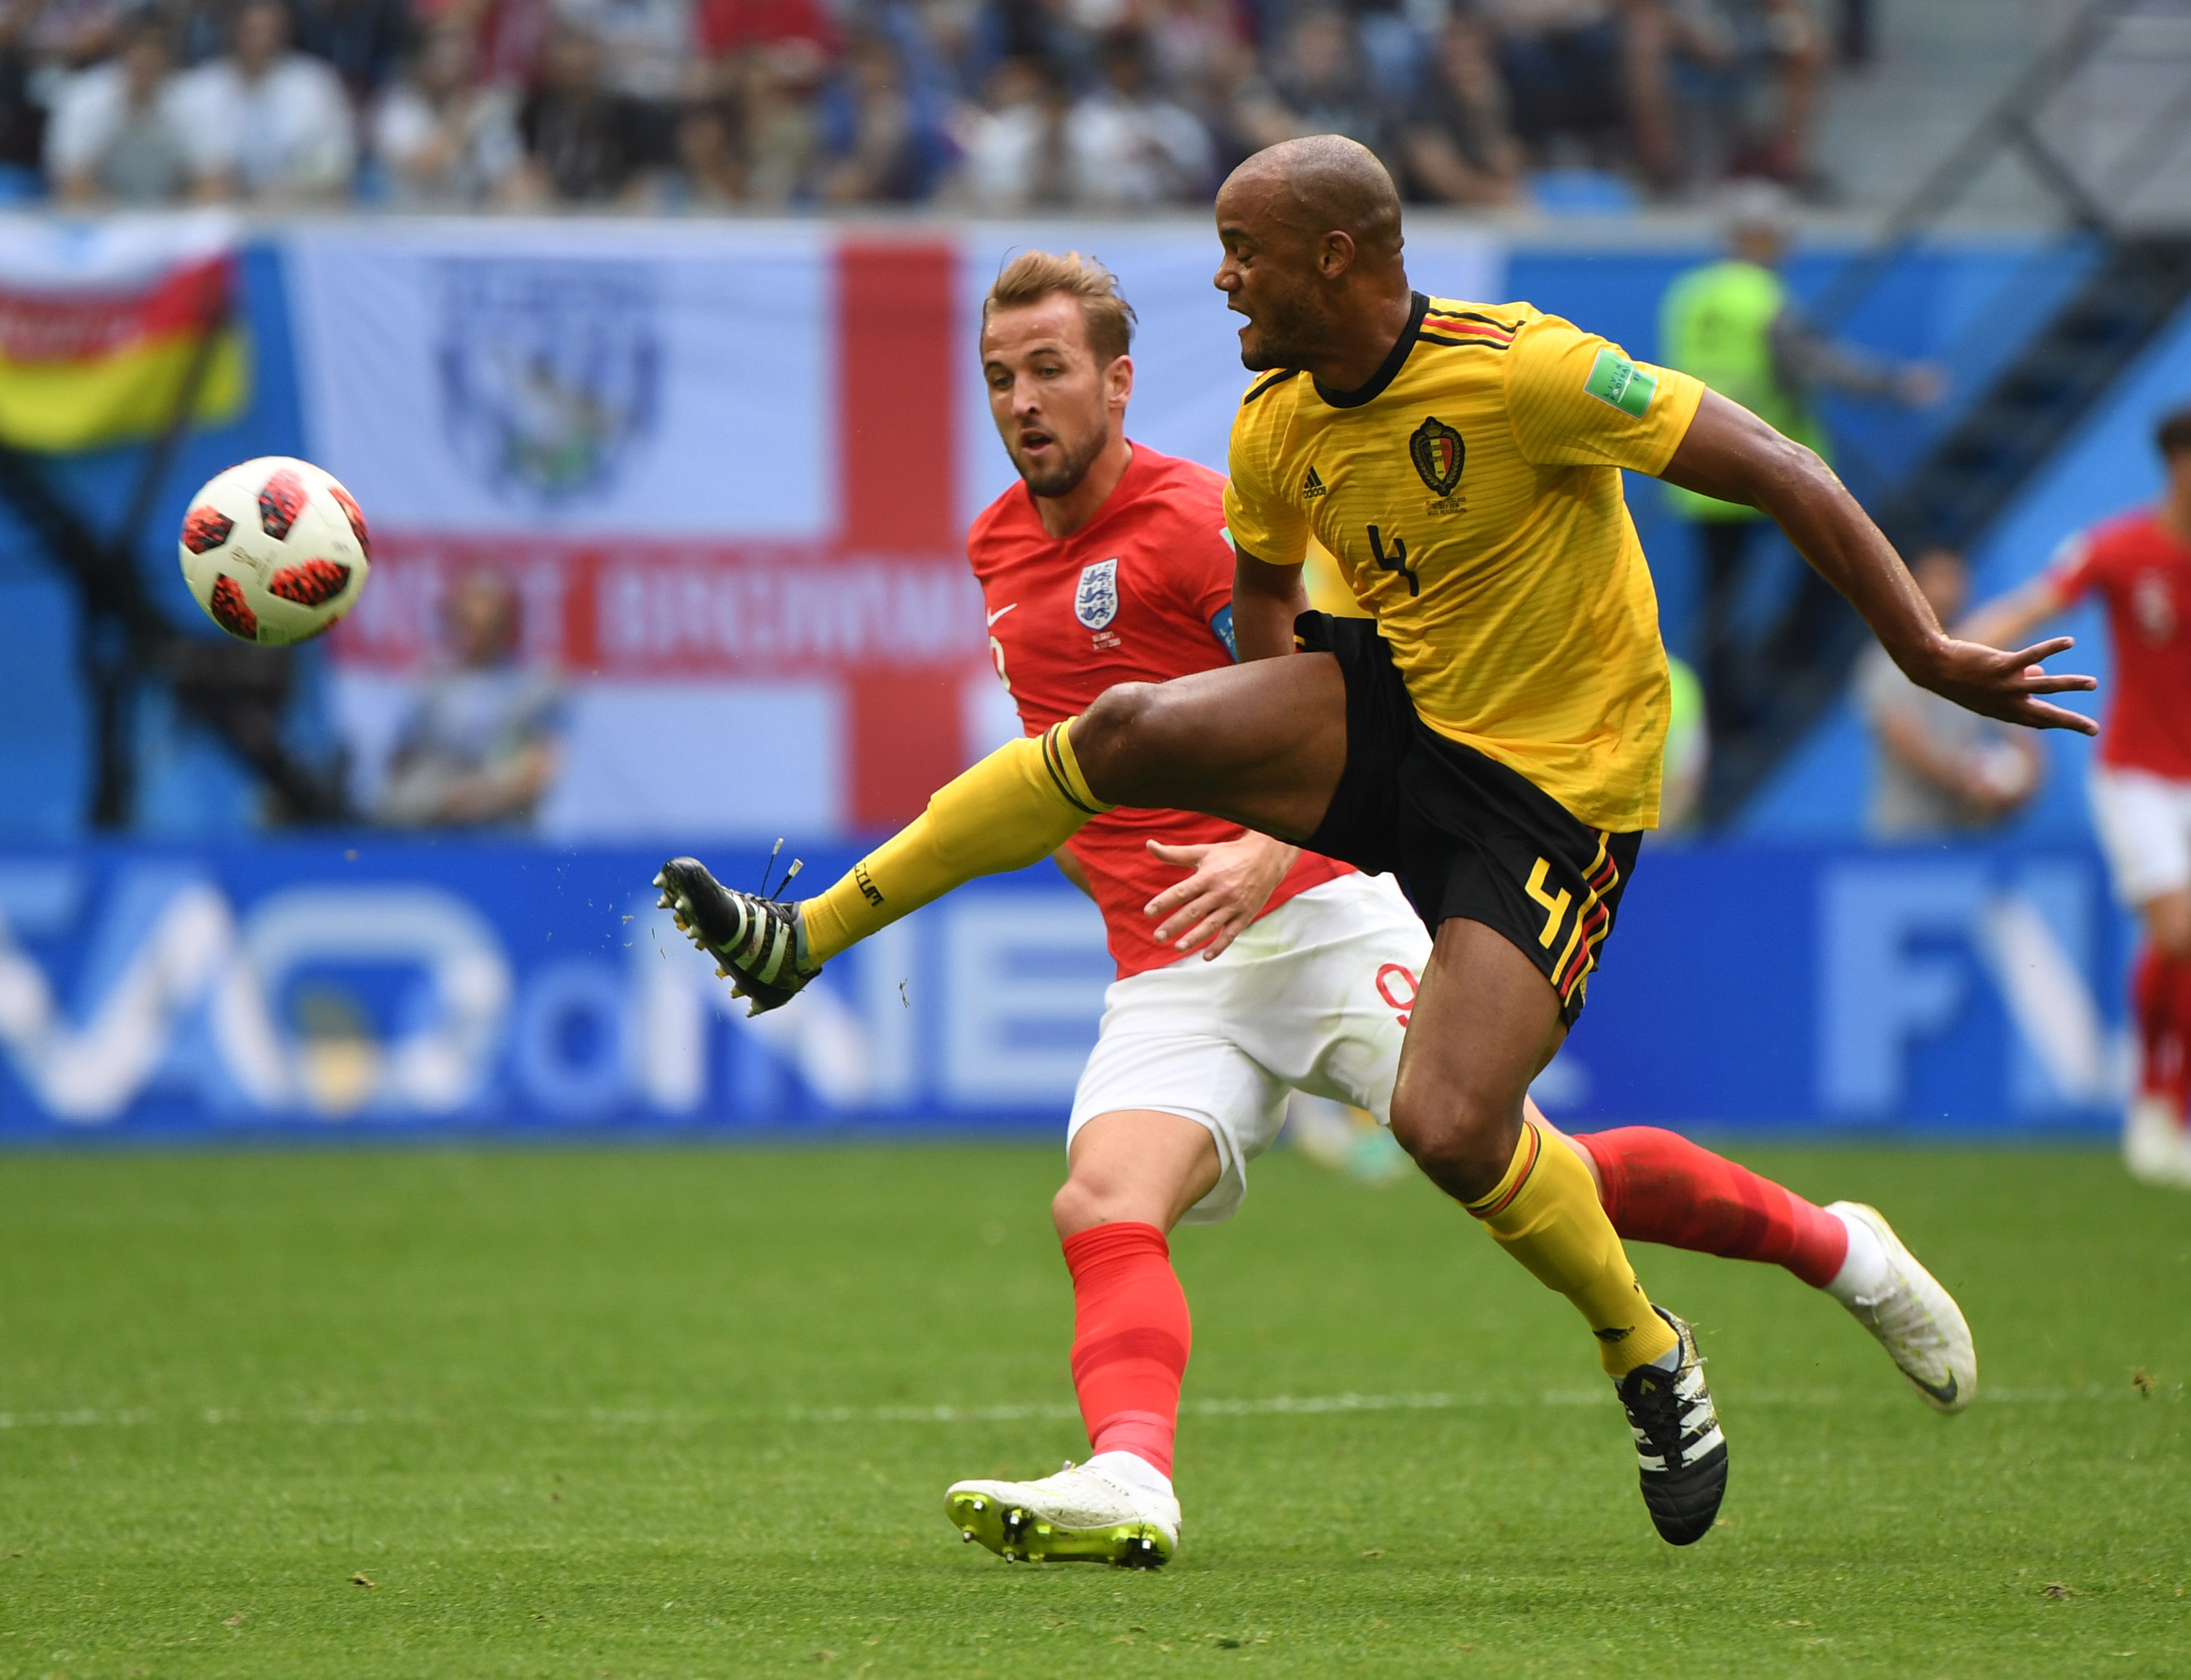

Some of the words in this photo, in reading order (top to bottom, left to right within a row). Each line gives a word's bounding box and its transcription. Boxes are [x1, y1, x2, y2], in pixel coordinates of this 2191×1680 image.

[1303, 486, 1326, 499] adidas
[1367, 524, 1419, 597] 4
[1525, 856, 1572, 949] 4
[1376, 963, 1419, 1028] 9
